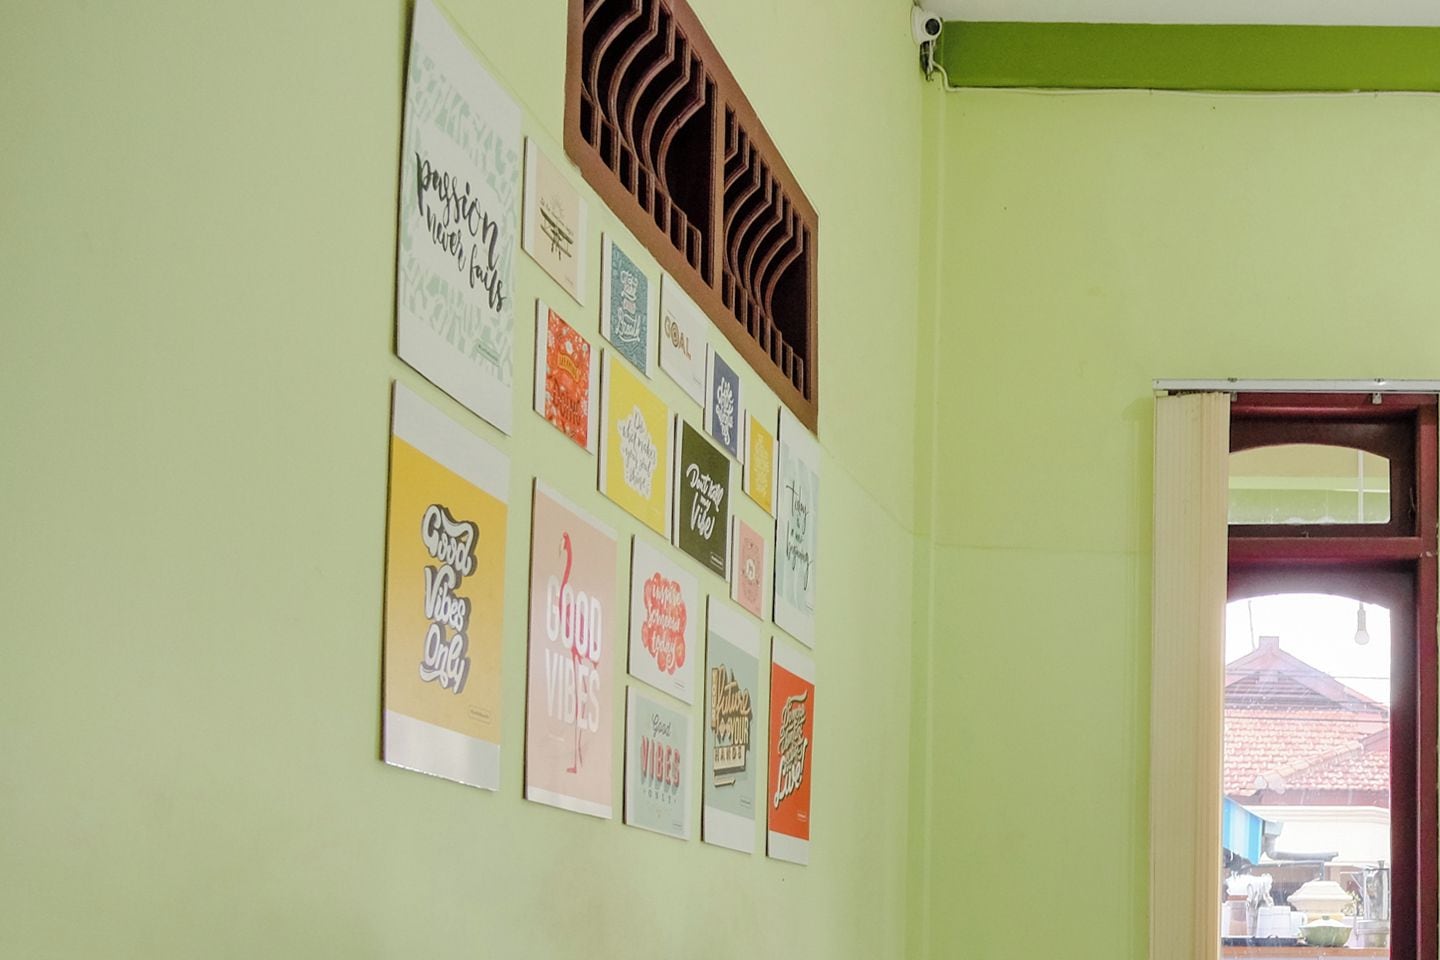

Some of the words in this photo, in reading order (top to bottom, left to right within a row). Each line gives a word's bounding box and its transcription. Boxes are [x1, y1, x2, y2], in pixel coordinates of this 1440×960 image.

[415, 152, 499, 272] passion
[427, 204, 466, 272] never
[470, 244, 506, 312] fails
[421, 504, 480, 576] Good
[424, 564, 472, 634] Vibes
[546, 575, 602, 663] GOOD
[419, 622, 471, 694] Only
[545, 648, 601, 733] VIBES
[640, 735, 681, 789] VIBES
